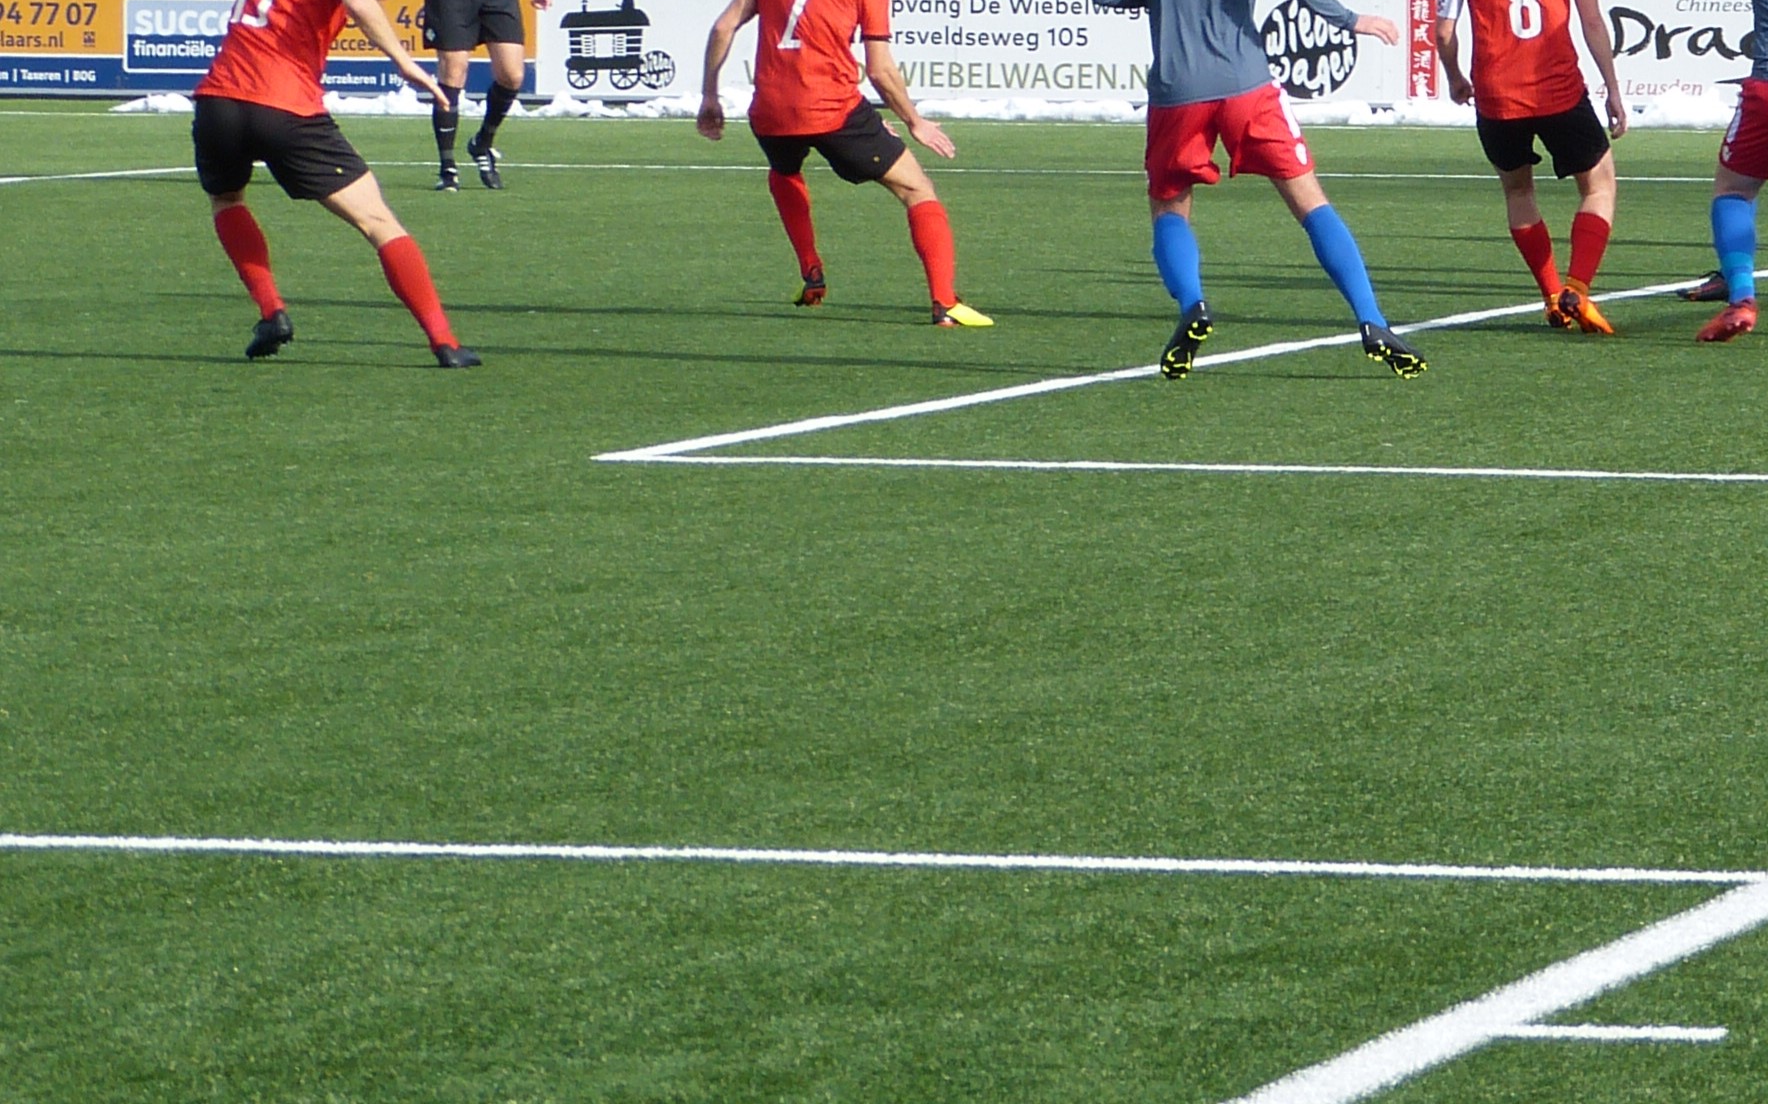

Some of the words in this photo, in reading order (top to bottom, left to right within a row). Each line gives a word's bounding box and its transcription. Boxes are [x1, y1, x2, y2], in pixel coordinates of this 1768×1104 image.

[0, 32, 64, 47] laars.nl
[1047, 27, 1088, 47] 105
[133, 39, 215, 56] financiële
[73, 71, 96, 82] BOG
